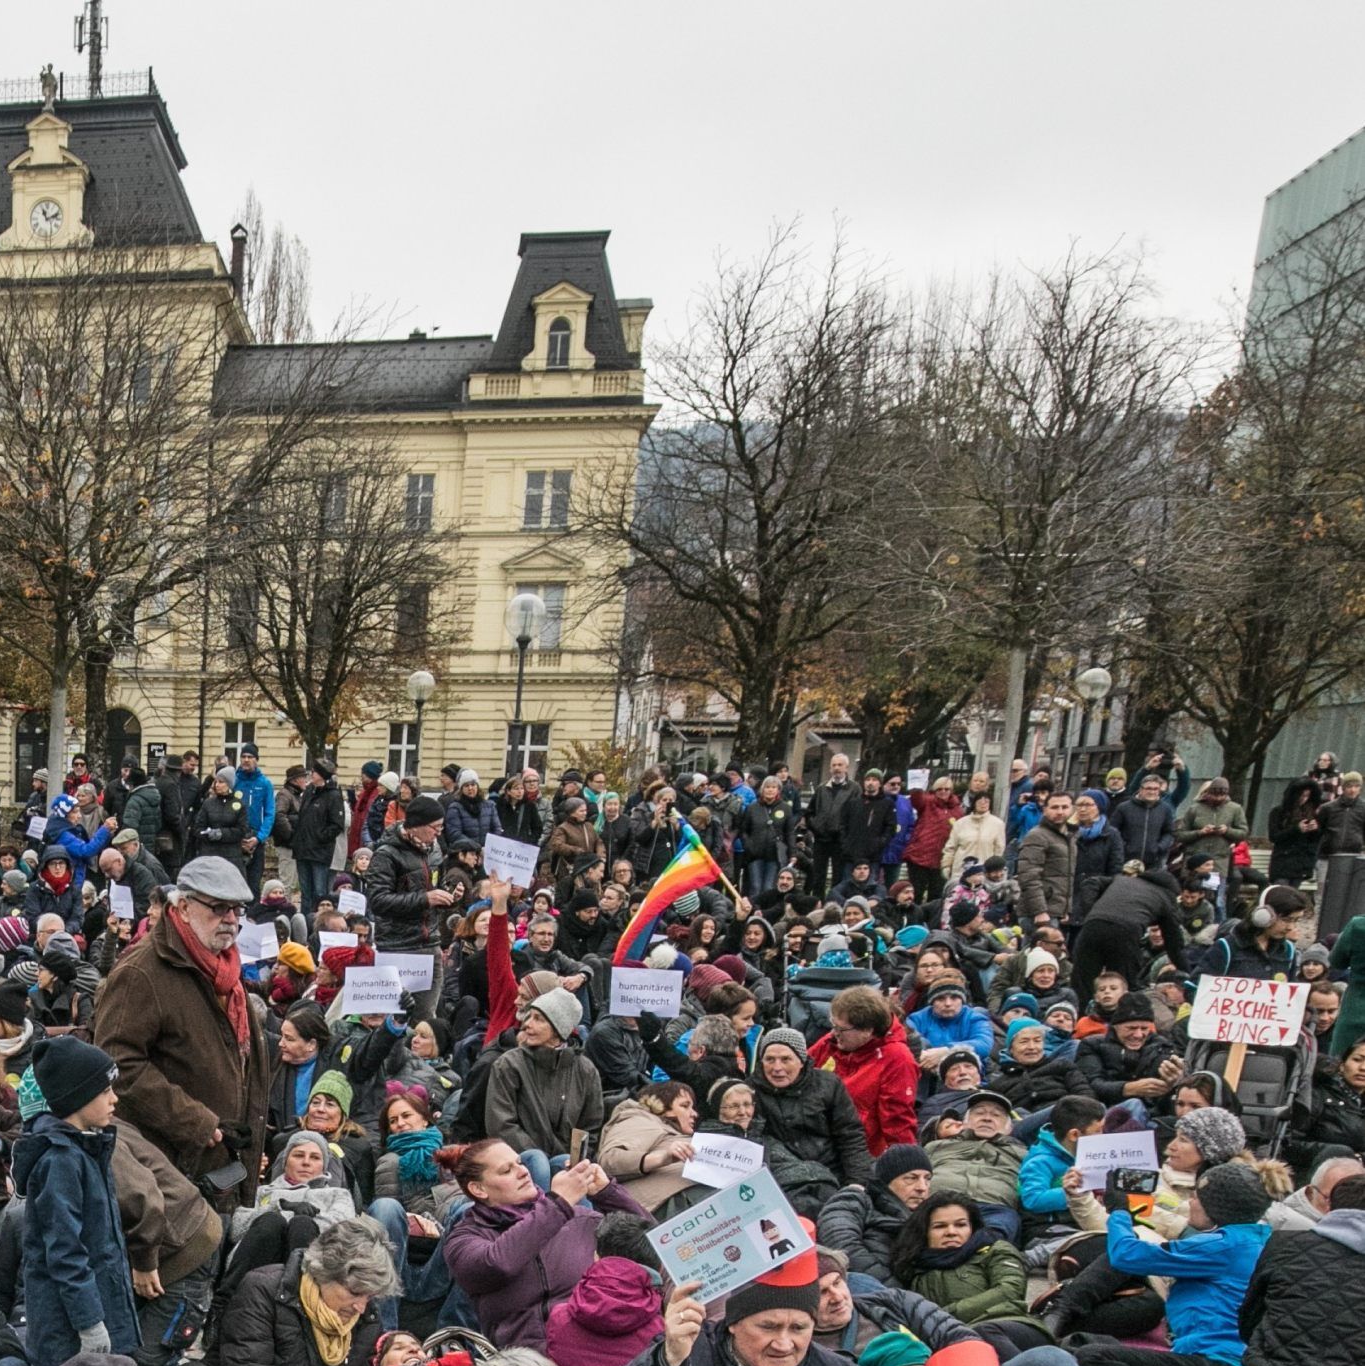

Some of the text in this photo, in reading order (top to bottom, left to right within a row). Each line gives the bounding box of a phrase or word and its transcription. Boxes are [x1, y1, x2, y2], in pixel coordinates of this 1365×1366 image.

[619, 982, 674, 992] humanitäres
[352, 993, 397, 1001] Bleiberecht
[620, 995, 670, 1006] Bleiberecht
[700, 1145, 753, 1166] Herz & Hirn
[1085, 1149, 1143, 1160] Herz & Hirn
[692, 1215, 742, 1245] Humanitäres
[697, 1226, 743, 1254] Bleiberecht
